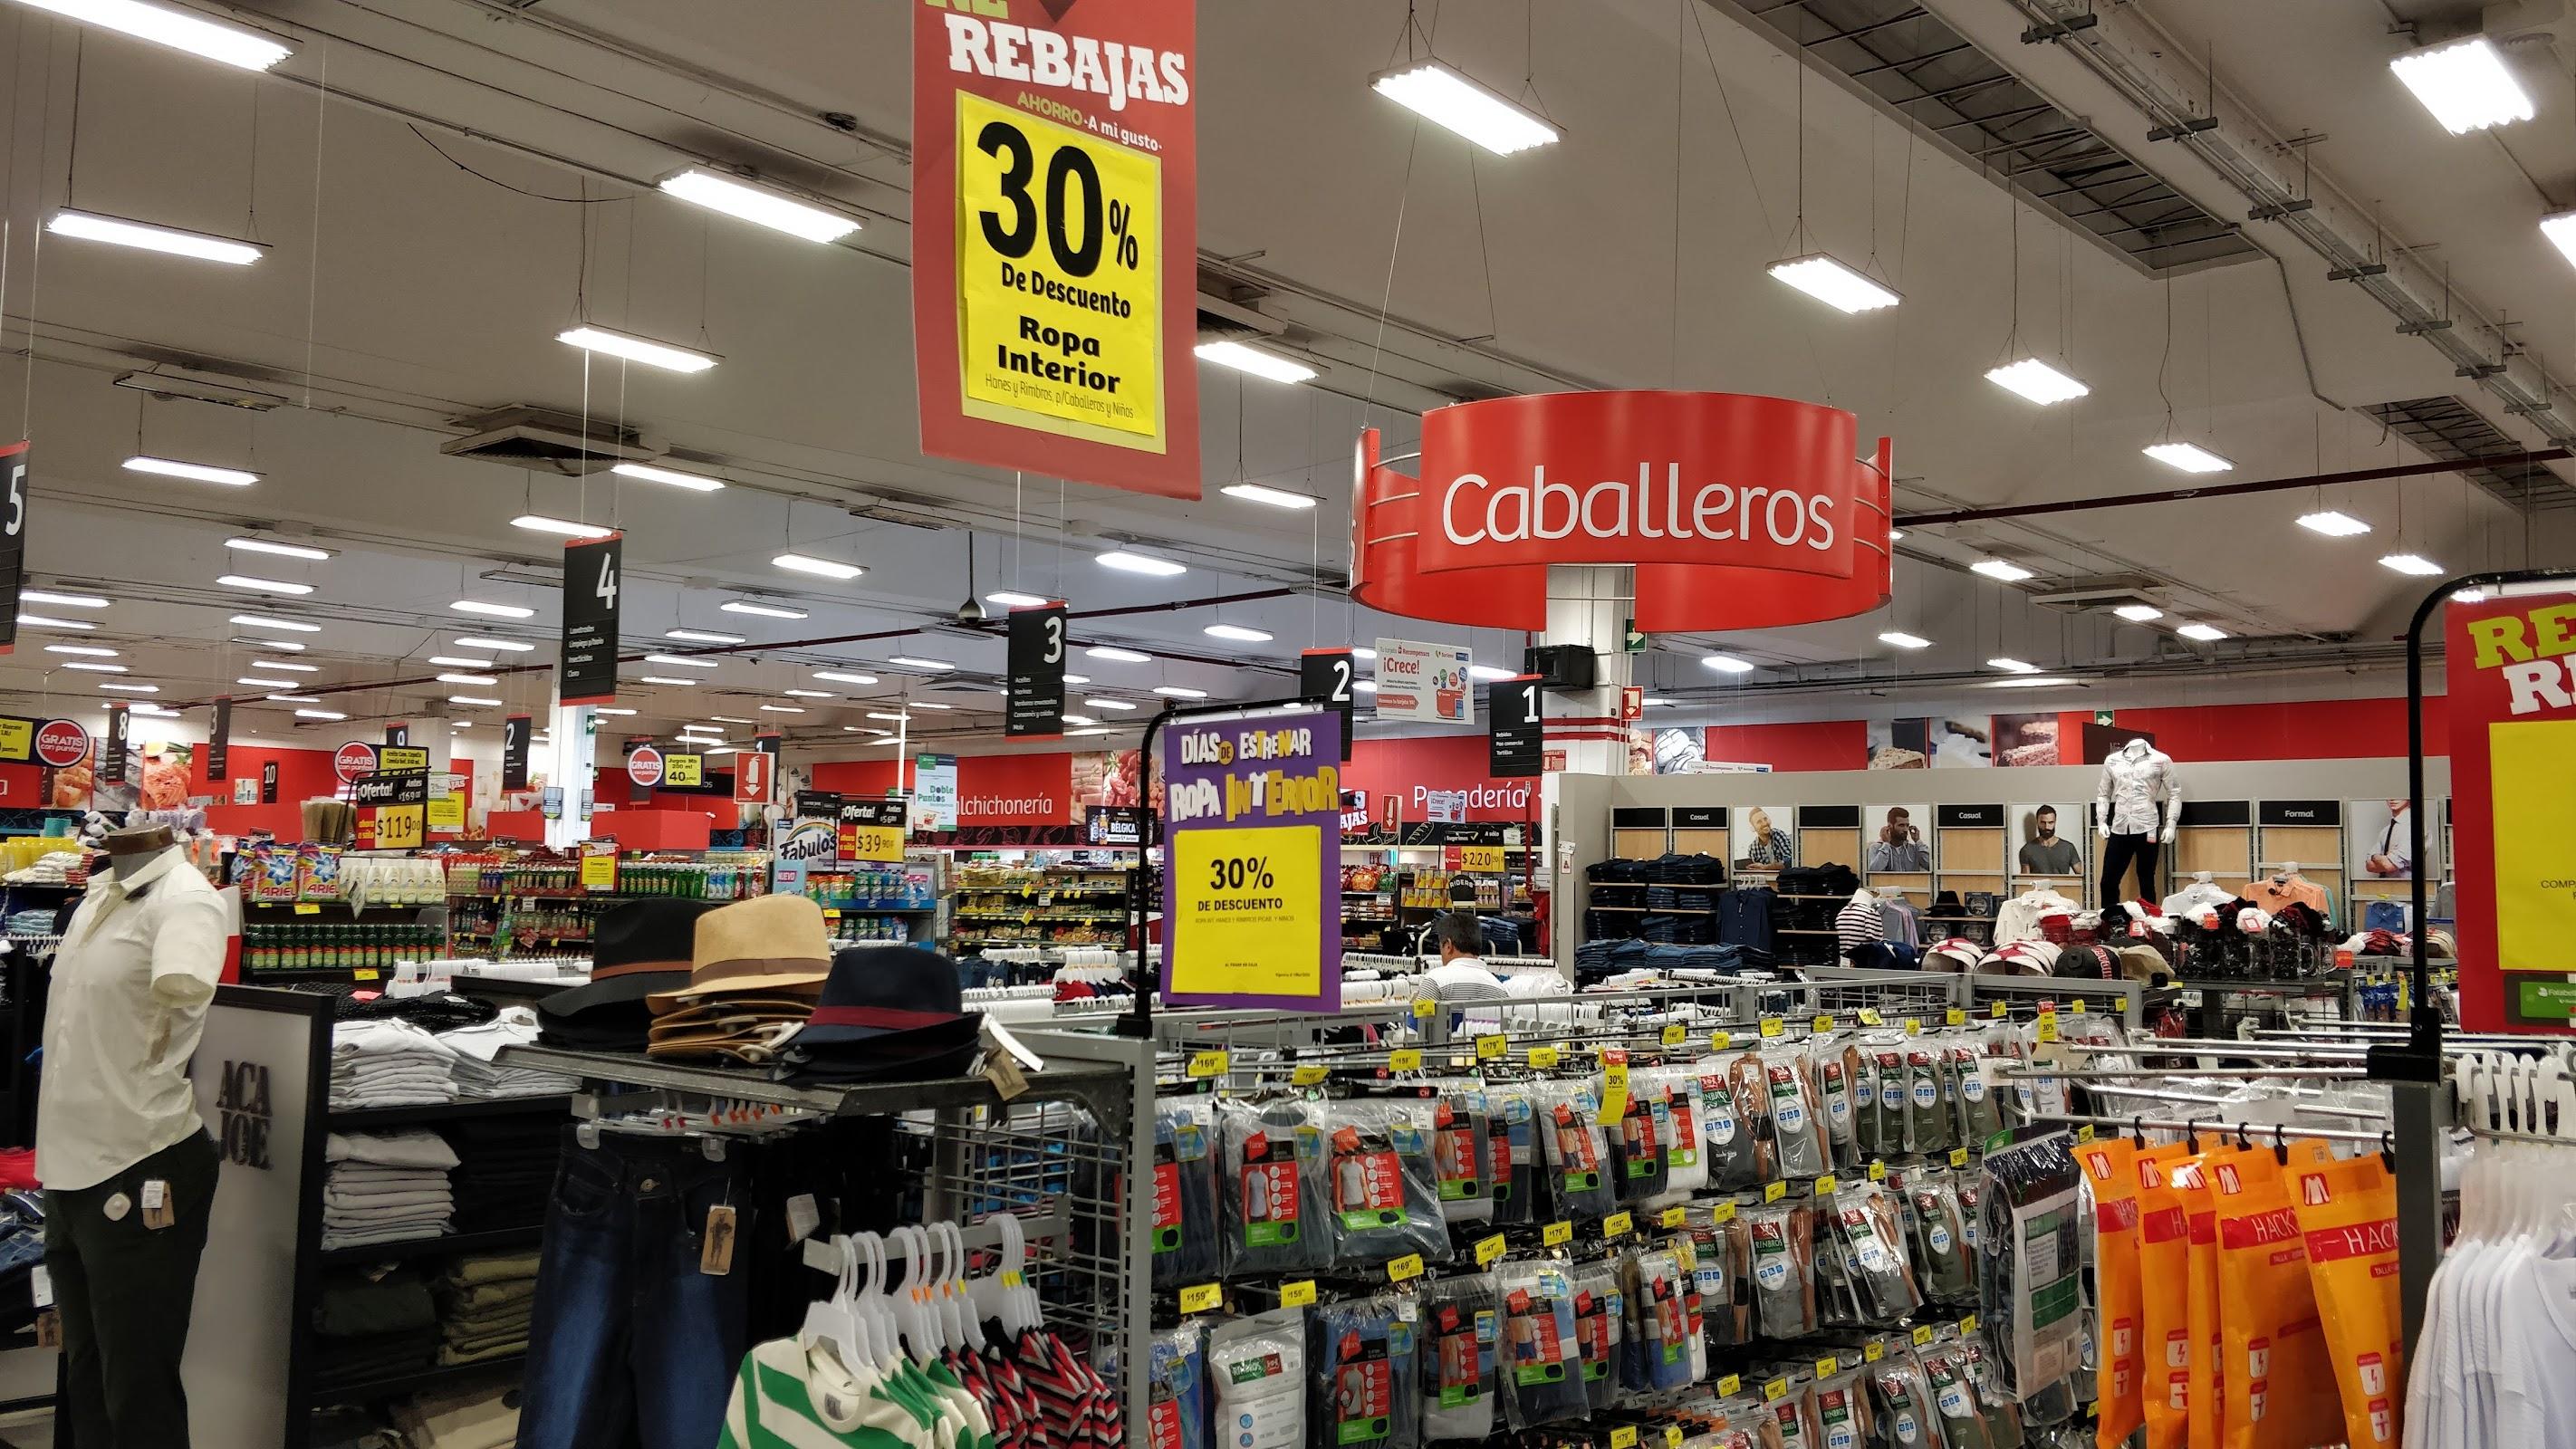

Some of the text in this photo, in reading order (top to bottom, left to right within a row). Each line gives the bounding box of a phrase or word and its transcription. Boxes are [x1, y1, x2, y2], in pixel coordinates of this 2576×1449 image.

[943, 13, 1189, 111] REBAJAS
[1016, 91, 1083, 127] AHORRO
[1101, 120, 1119, 138] mi
[1001, 261, 1131, 319] De Descuento
[1019, 315, 1101, 358] Ropa
[997, 344, 1121, 394] Interior
[985, 373, 1012, 391] Hanes
[1013, 382, 1019, 398] y
[1112, 401, 1134, 418] Niños
[5, 464, 26, 536] 5
[1442, 461, 1835, 552] Caballeros
[596, 552, 618, 609] 4
[1043, 616, 1062, 664] 3
[1383, 657, 1420, 675] ¡Crece!
[1331, 660, 1350, 702] 2
[1522, 686, 1540, 724] 1
[118, 712, 129, 741] 8
[505, 723, 515, 751] 2
[41, 734, 84, 747] GRATIS
[1181, 727, 1312, 765] DÍAS DE ESTRENAR
[339, 756, 373, 765] GRATIS
[631, 761, 660, 770] GRATIS
[264, 764, 276, 784] 10
[669, 772, 686, 782] 40
[357, 782, 393, 801] ¡Oferta!
[918, 793, 946, 802] Puntos
[929, 785, 954, 794] Doble
[1169, 766, 1340, 823] ROPA INTERIOR
[1414, 781, 1525, 809] Pdería
[841, 805, 876, 820] ¡Oferta!
[886, 805, 902, 813] Antes
[956, 792, 1053, 816] lchichonería
[2284, 810, 2314, 818] Formal
[1110, 820, 1137, 833] BÉLGICA
[1341, 810, 1369, 831] AJAS
[779, 833, 837, 860] Fabulos
[1209, 855, 1274, 890] 30%
[2541, 879, 2576, 888] COMP
[261, 887, 296, 897] ARIEL
[308, 884, 339, 894] ARIEL
[1197, 897, 1283, 912] DE DESCUENTO
[216, 1060, 273, 1118] ACA
[1608, 1075, 1624, 1085] 30%
[220, 1110, 274, 1171] JOE
[2251, 1210, 2296, 1242] HACK
[1755, 1239, 1783, 1249] RINBROS
[1782, 1421, 1796, 1431] NBROS
